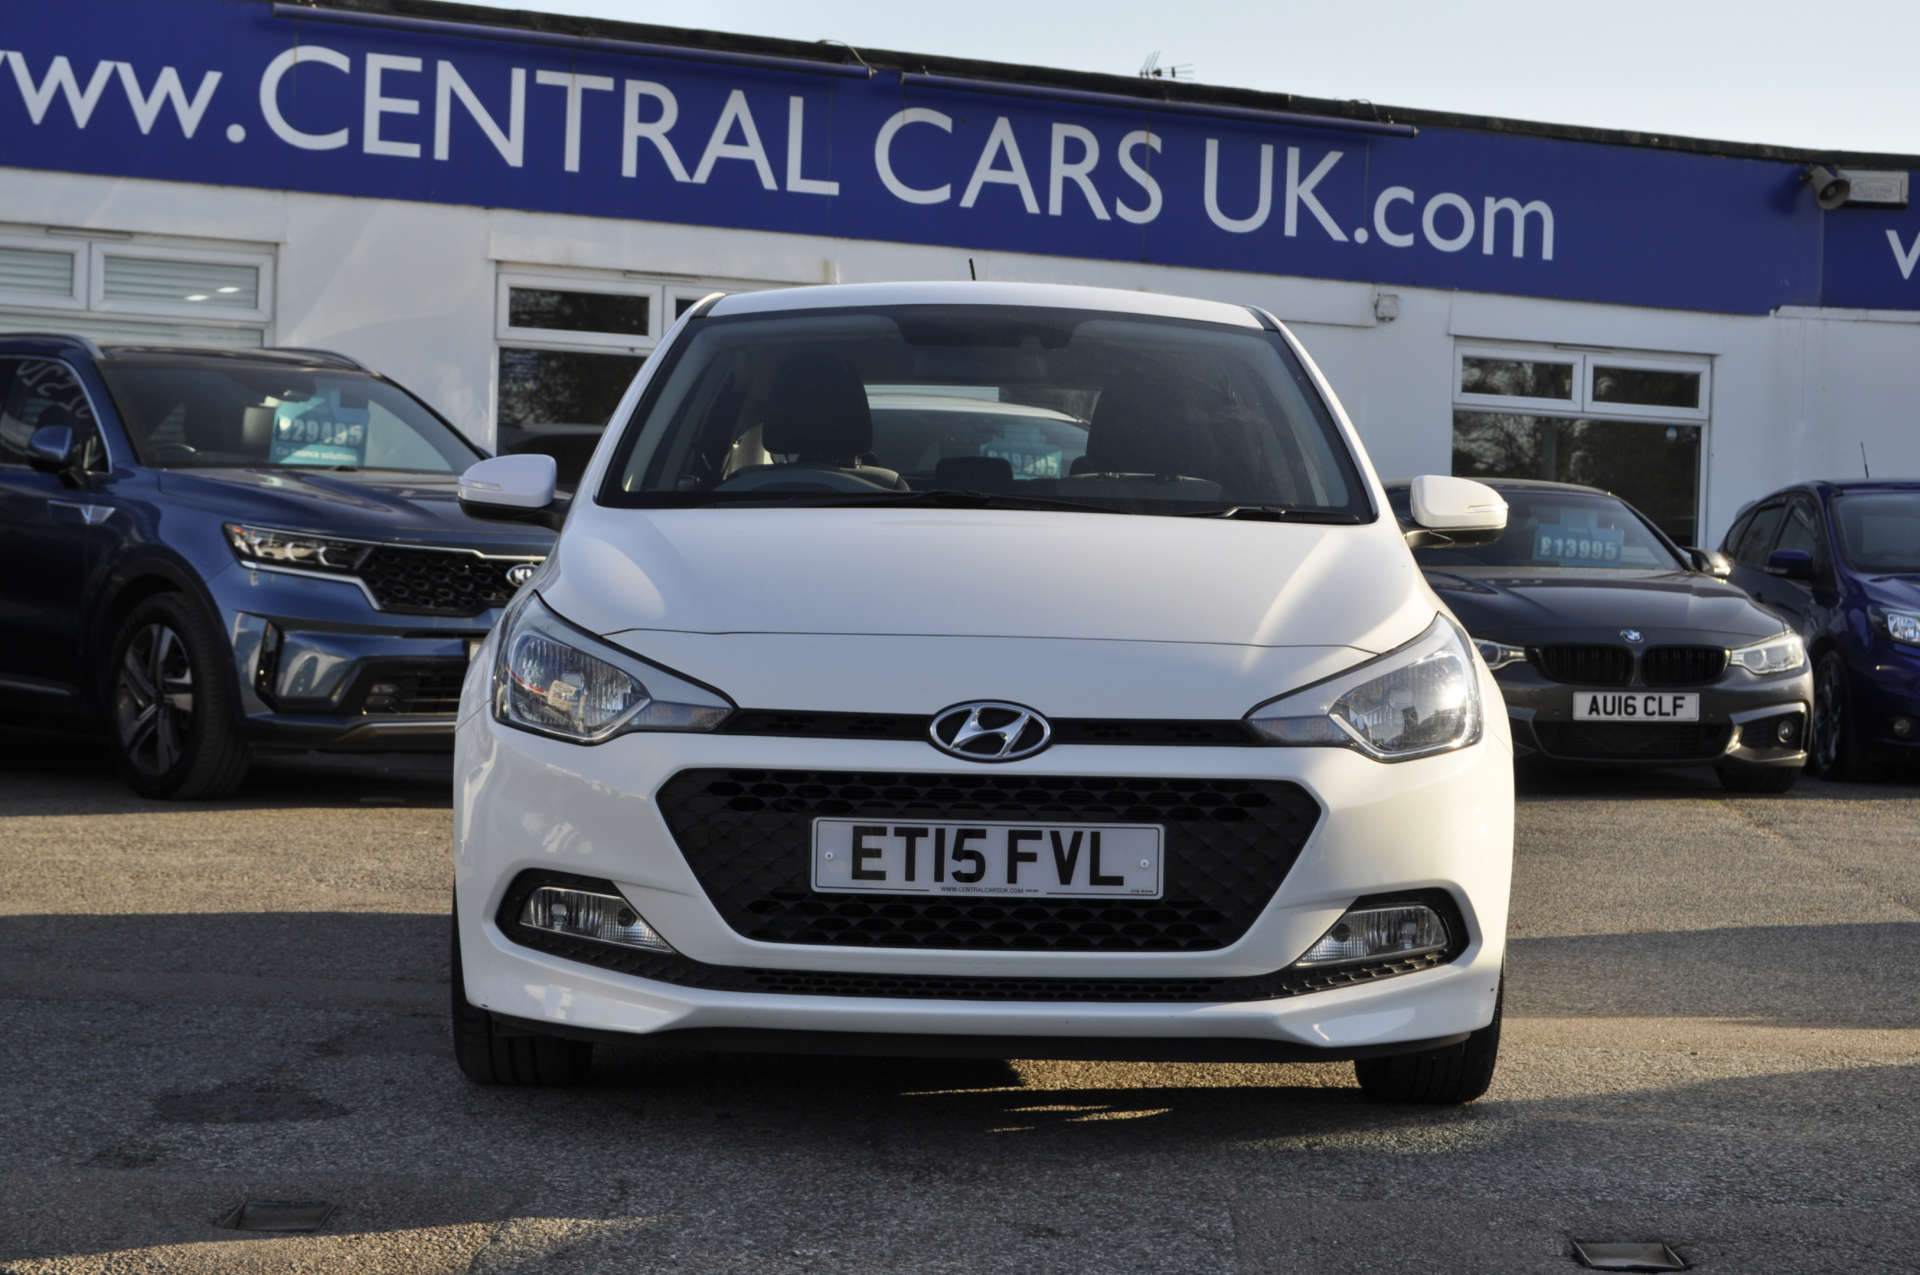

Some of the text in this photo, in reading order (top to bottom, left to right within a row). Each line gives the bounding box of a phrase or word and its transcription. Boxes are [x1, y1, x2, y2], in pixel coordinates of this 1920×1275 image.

[0, 45, 1554, 261] ww.CENTRAL CARS UK.com
[1539, 535, 1617, 560] £13995
[1587, 694, 1686, 718] AU16 CLF
[850, 825, 1125, 887] ET15 FVL
